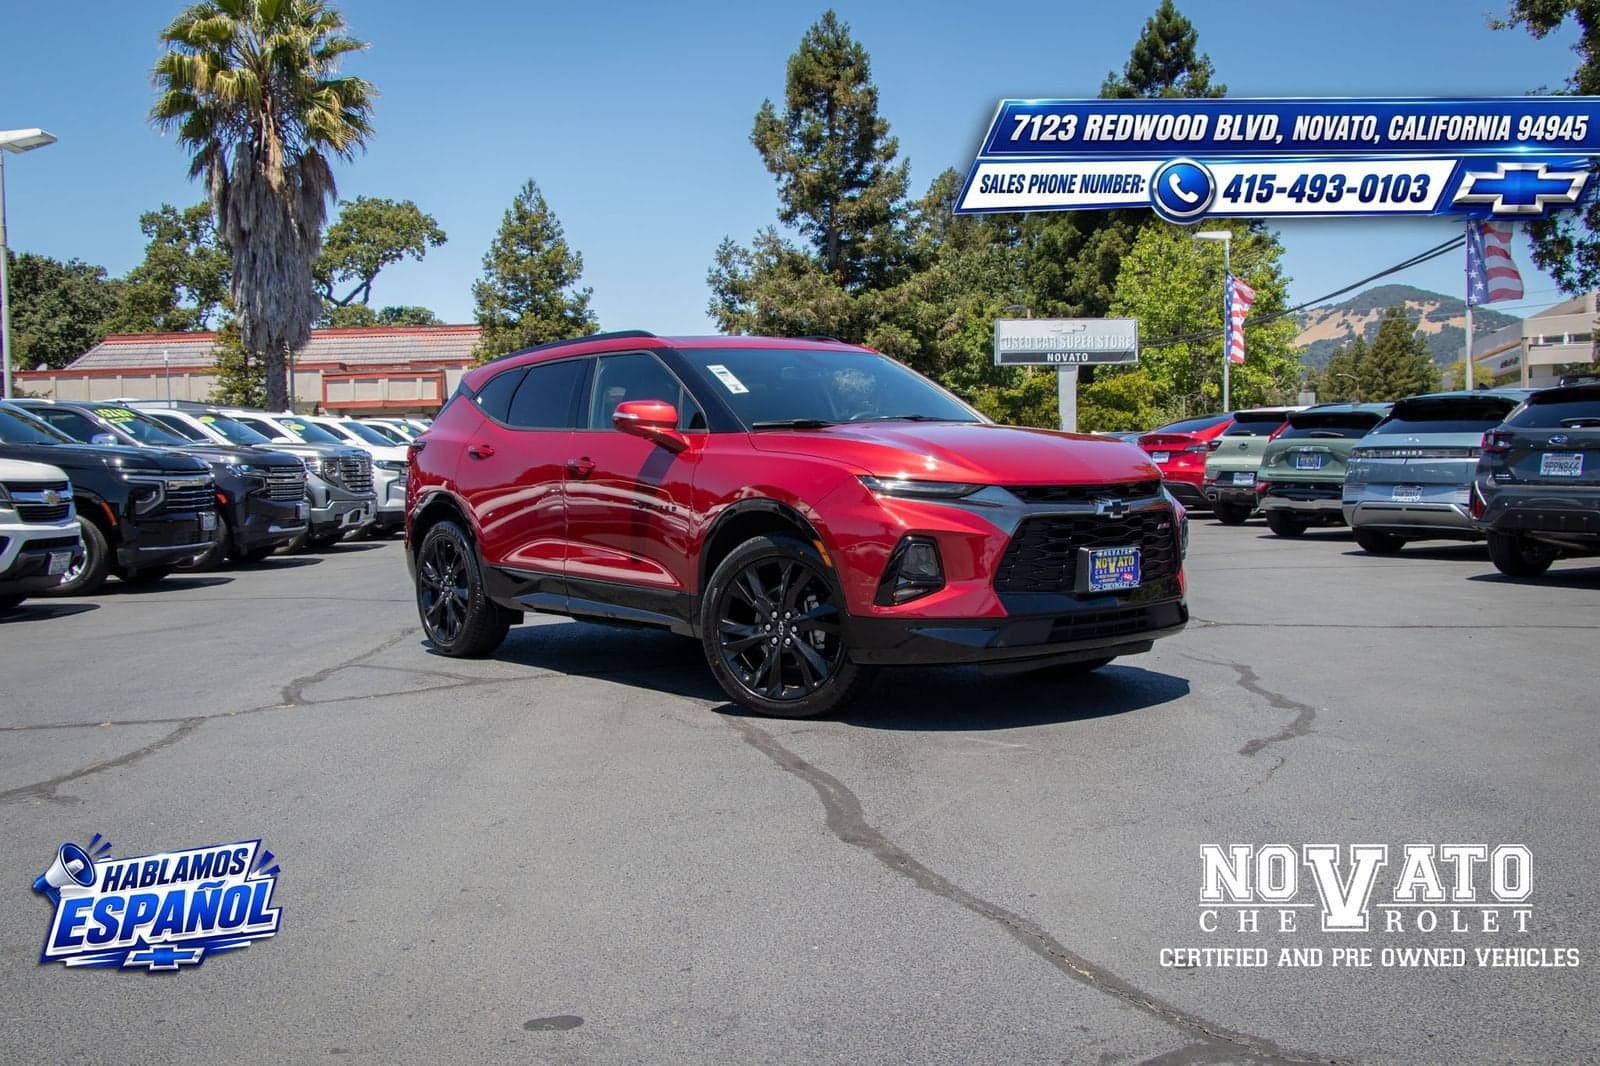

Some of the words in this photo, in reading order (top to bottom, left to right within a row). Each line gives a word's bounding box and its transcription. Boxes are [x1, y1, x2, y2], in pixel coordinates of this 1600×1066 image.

[1005, 336, 1033, 349] USED
[1035, 336, 1057, 349] CAR
[1047, 352, 1089, 362] NOVATO
[1095, 556, 1135, 573] NOVATO
